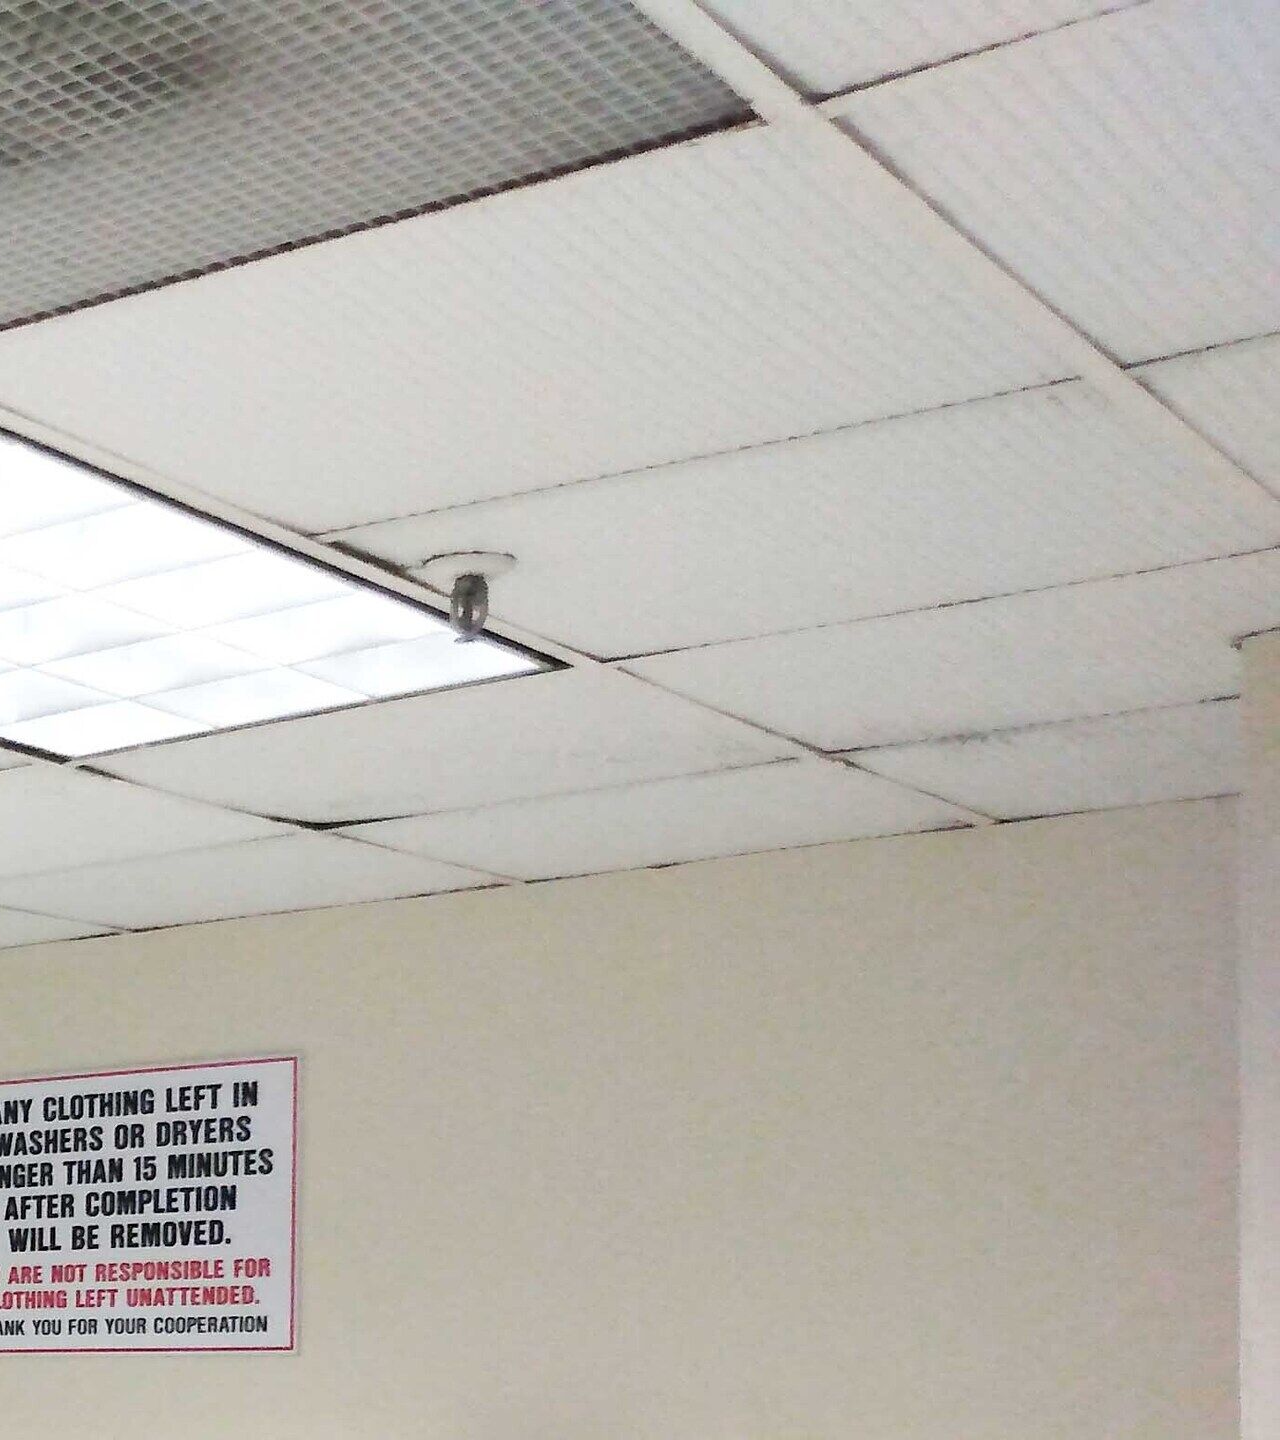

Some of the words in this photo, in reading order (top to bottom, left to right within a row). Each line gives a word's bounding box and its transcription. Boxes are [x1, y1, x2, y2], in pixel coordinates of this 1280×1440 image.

[43, 1089, 154, 1122] CLOTHING
[166, 1084, 221, 1112] LEFT
[233, 1081, 257, 1107] IN
[115, 1123, 144, 1149] OR
[156, 1116, 250, 1147] DRYERS
[63, 1157, 123, 1185] THAN
[134, 1156, 156, 1181] 15
[168, 1149, 273, 1179] MINUTES
[5, 1193, 74, 1220] AFTER
[86, 1185, 237, 1216] COMPLETION
[9, 1227, 61, 1252] WILL
[72, 1226, 98, 1250] BE
[111, 1220, 230, 1248] REMOVED.
[8, 1265, 41, 1284] ARE
[52, 1263, 85, 1283] NOT
[95, 1260, 223, 1282] RESPONSIBLE
[234, 1258, 270, 1277] FOR
[76, 1289, 118, 1308] LEFT
[127, 1285, 259, 1307] UNATTENDED.
[32, 1319, 62, 1335] YOU
[69, 1319, 97, 1334] FOR
[105, 1318, 146, 1333] YOUR
[154, 1316, 267, 1332] COOPERATION
